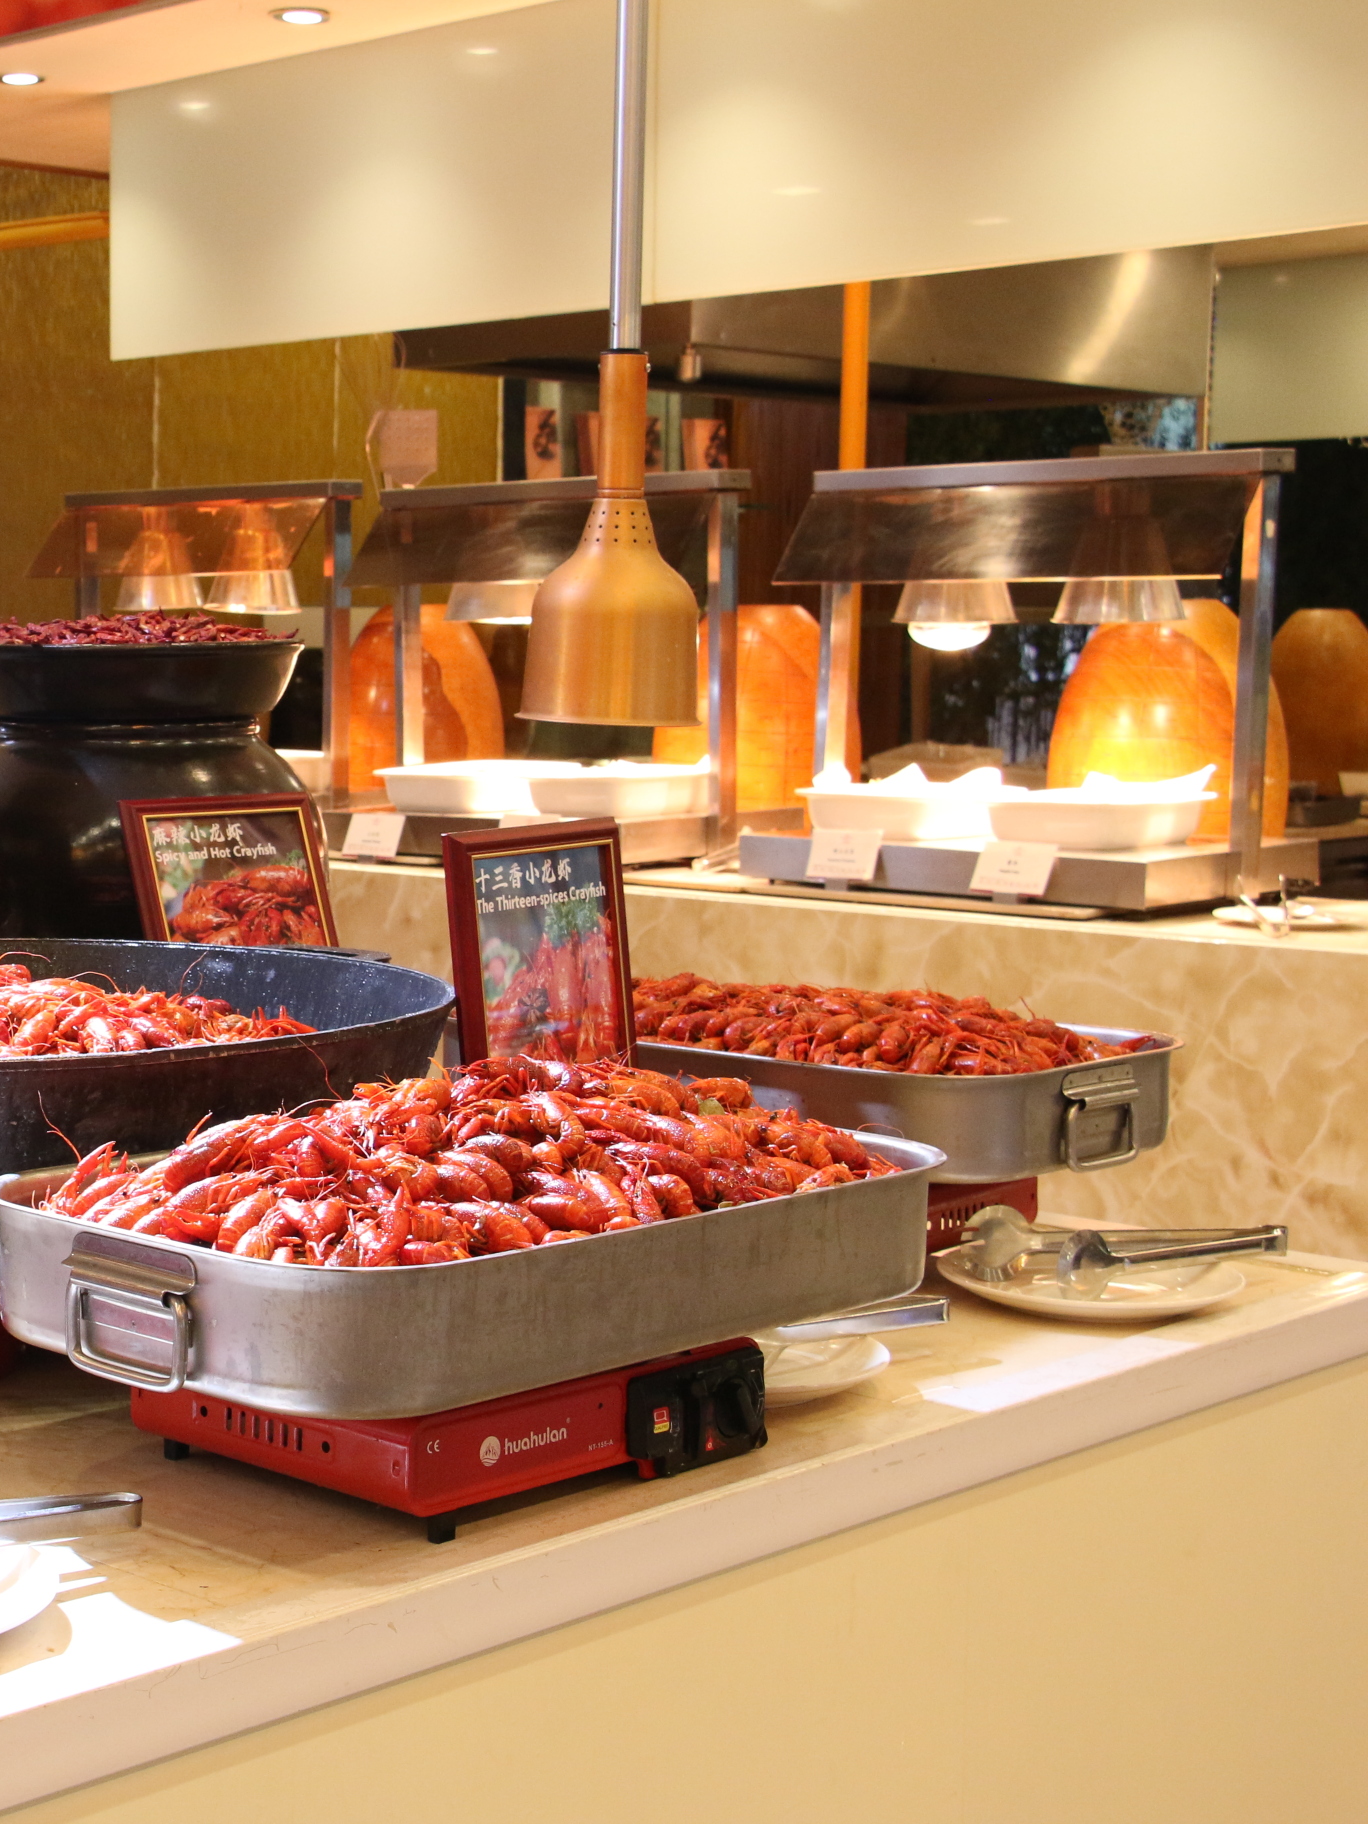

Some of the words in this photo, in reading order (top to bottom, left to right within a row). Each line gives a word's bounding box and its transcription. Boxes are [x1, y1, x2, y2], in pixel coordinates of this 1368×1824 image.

[152, 823, 243, 846] 麻辣小龙虾
[155, 849, 186, 865] Spicy
[188, 847, 208, 860] and
[210, 847, 231, 859] Hot
[233, 843, 277, 859] Crayfish
[475, 858, 571, 893] 十三香小龙虾
[477, 898, 494, 914] The
[496, 889, 568, 911] Thirteen-spices
[569, 881, 606, 902] Crayfish
[504, 1427, 567, 1455] huahulan
